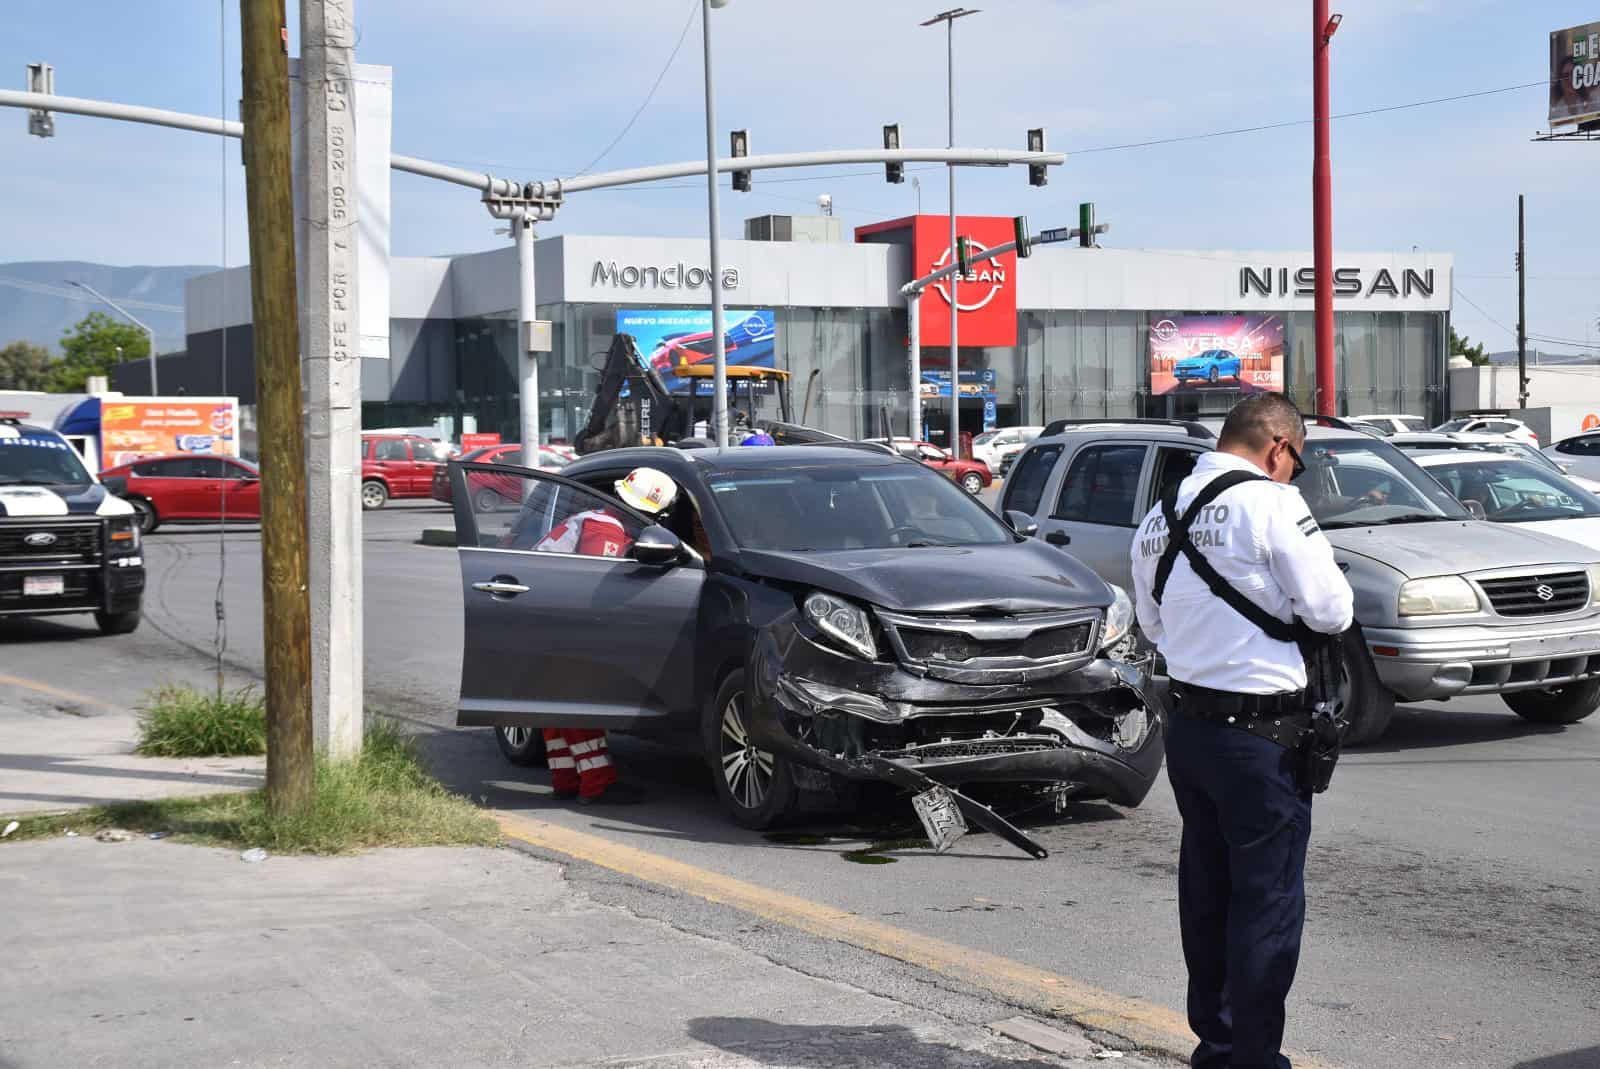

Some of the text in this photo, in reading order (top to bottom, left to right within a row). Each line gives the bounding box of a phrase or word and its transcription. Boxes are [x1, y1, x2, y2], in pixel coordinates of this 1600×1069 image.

[1239, 267, 1435, 298] NISSAN
[1183, 336, 1253, 352] VERSA
[1145, 504, 1230, 535] TRITO
